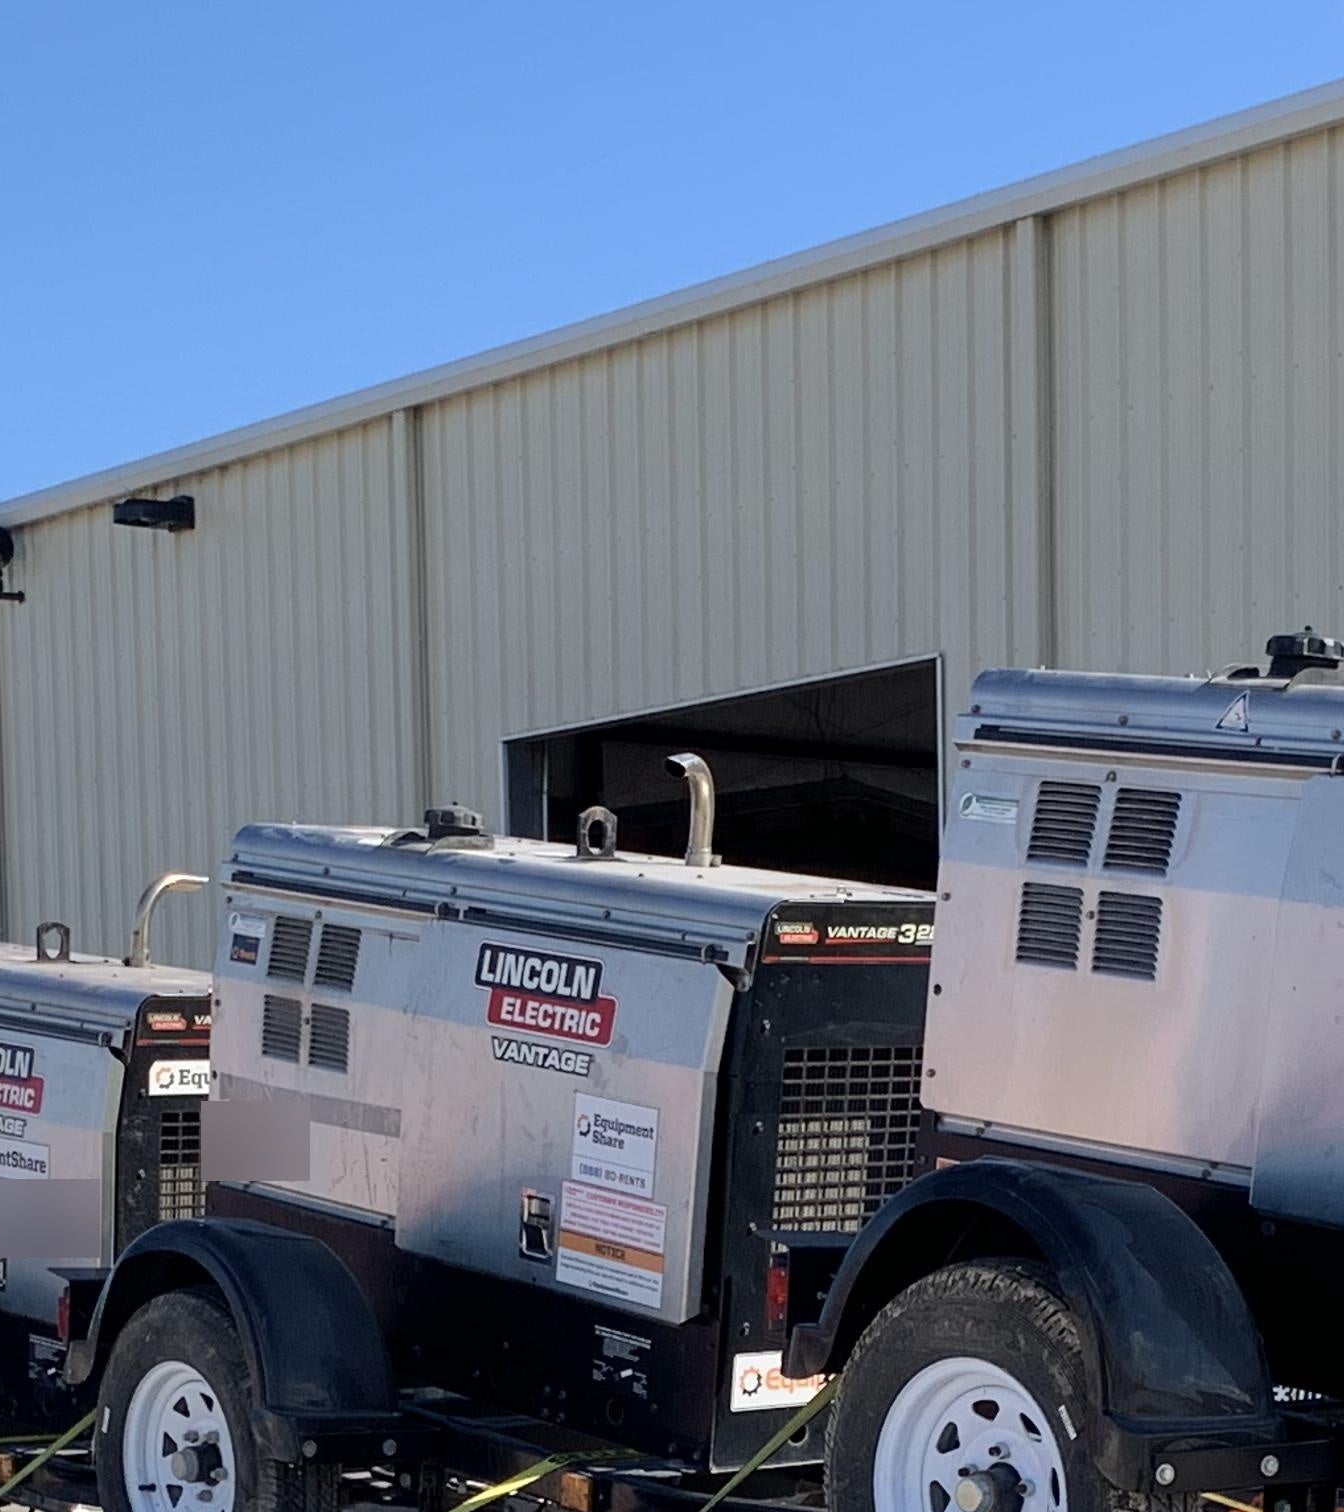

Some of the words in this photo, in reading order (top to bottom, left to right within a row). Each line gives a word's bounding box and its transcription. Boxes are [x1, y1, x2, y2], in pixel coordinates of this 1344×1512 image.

[826, 925, 899, 939] VANTAGE
[480, 949, 596, 1001] LINCOLN
[500, 996, 602, 1038] ELECTRIC
[492, 1036, 594, 1078] VANTAGE
[592, 1113, 655, 1141] Equipment
[592, 1130, 625, 1150] Share
